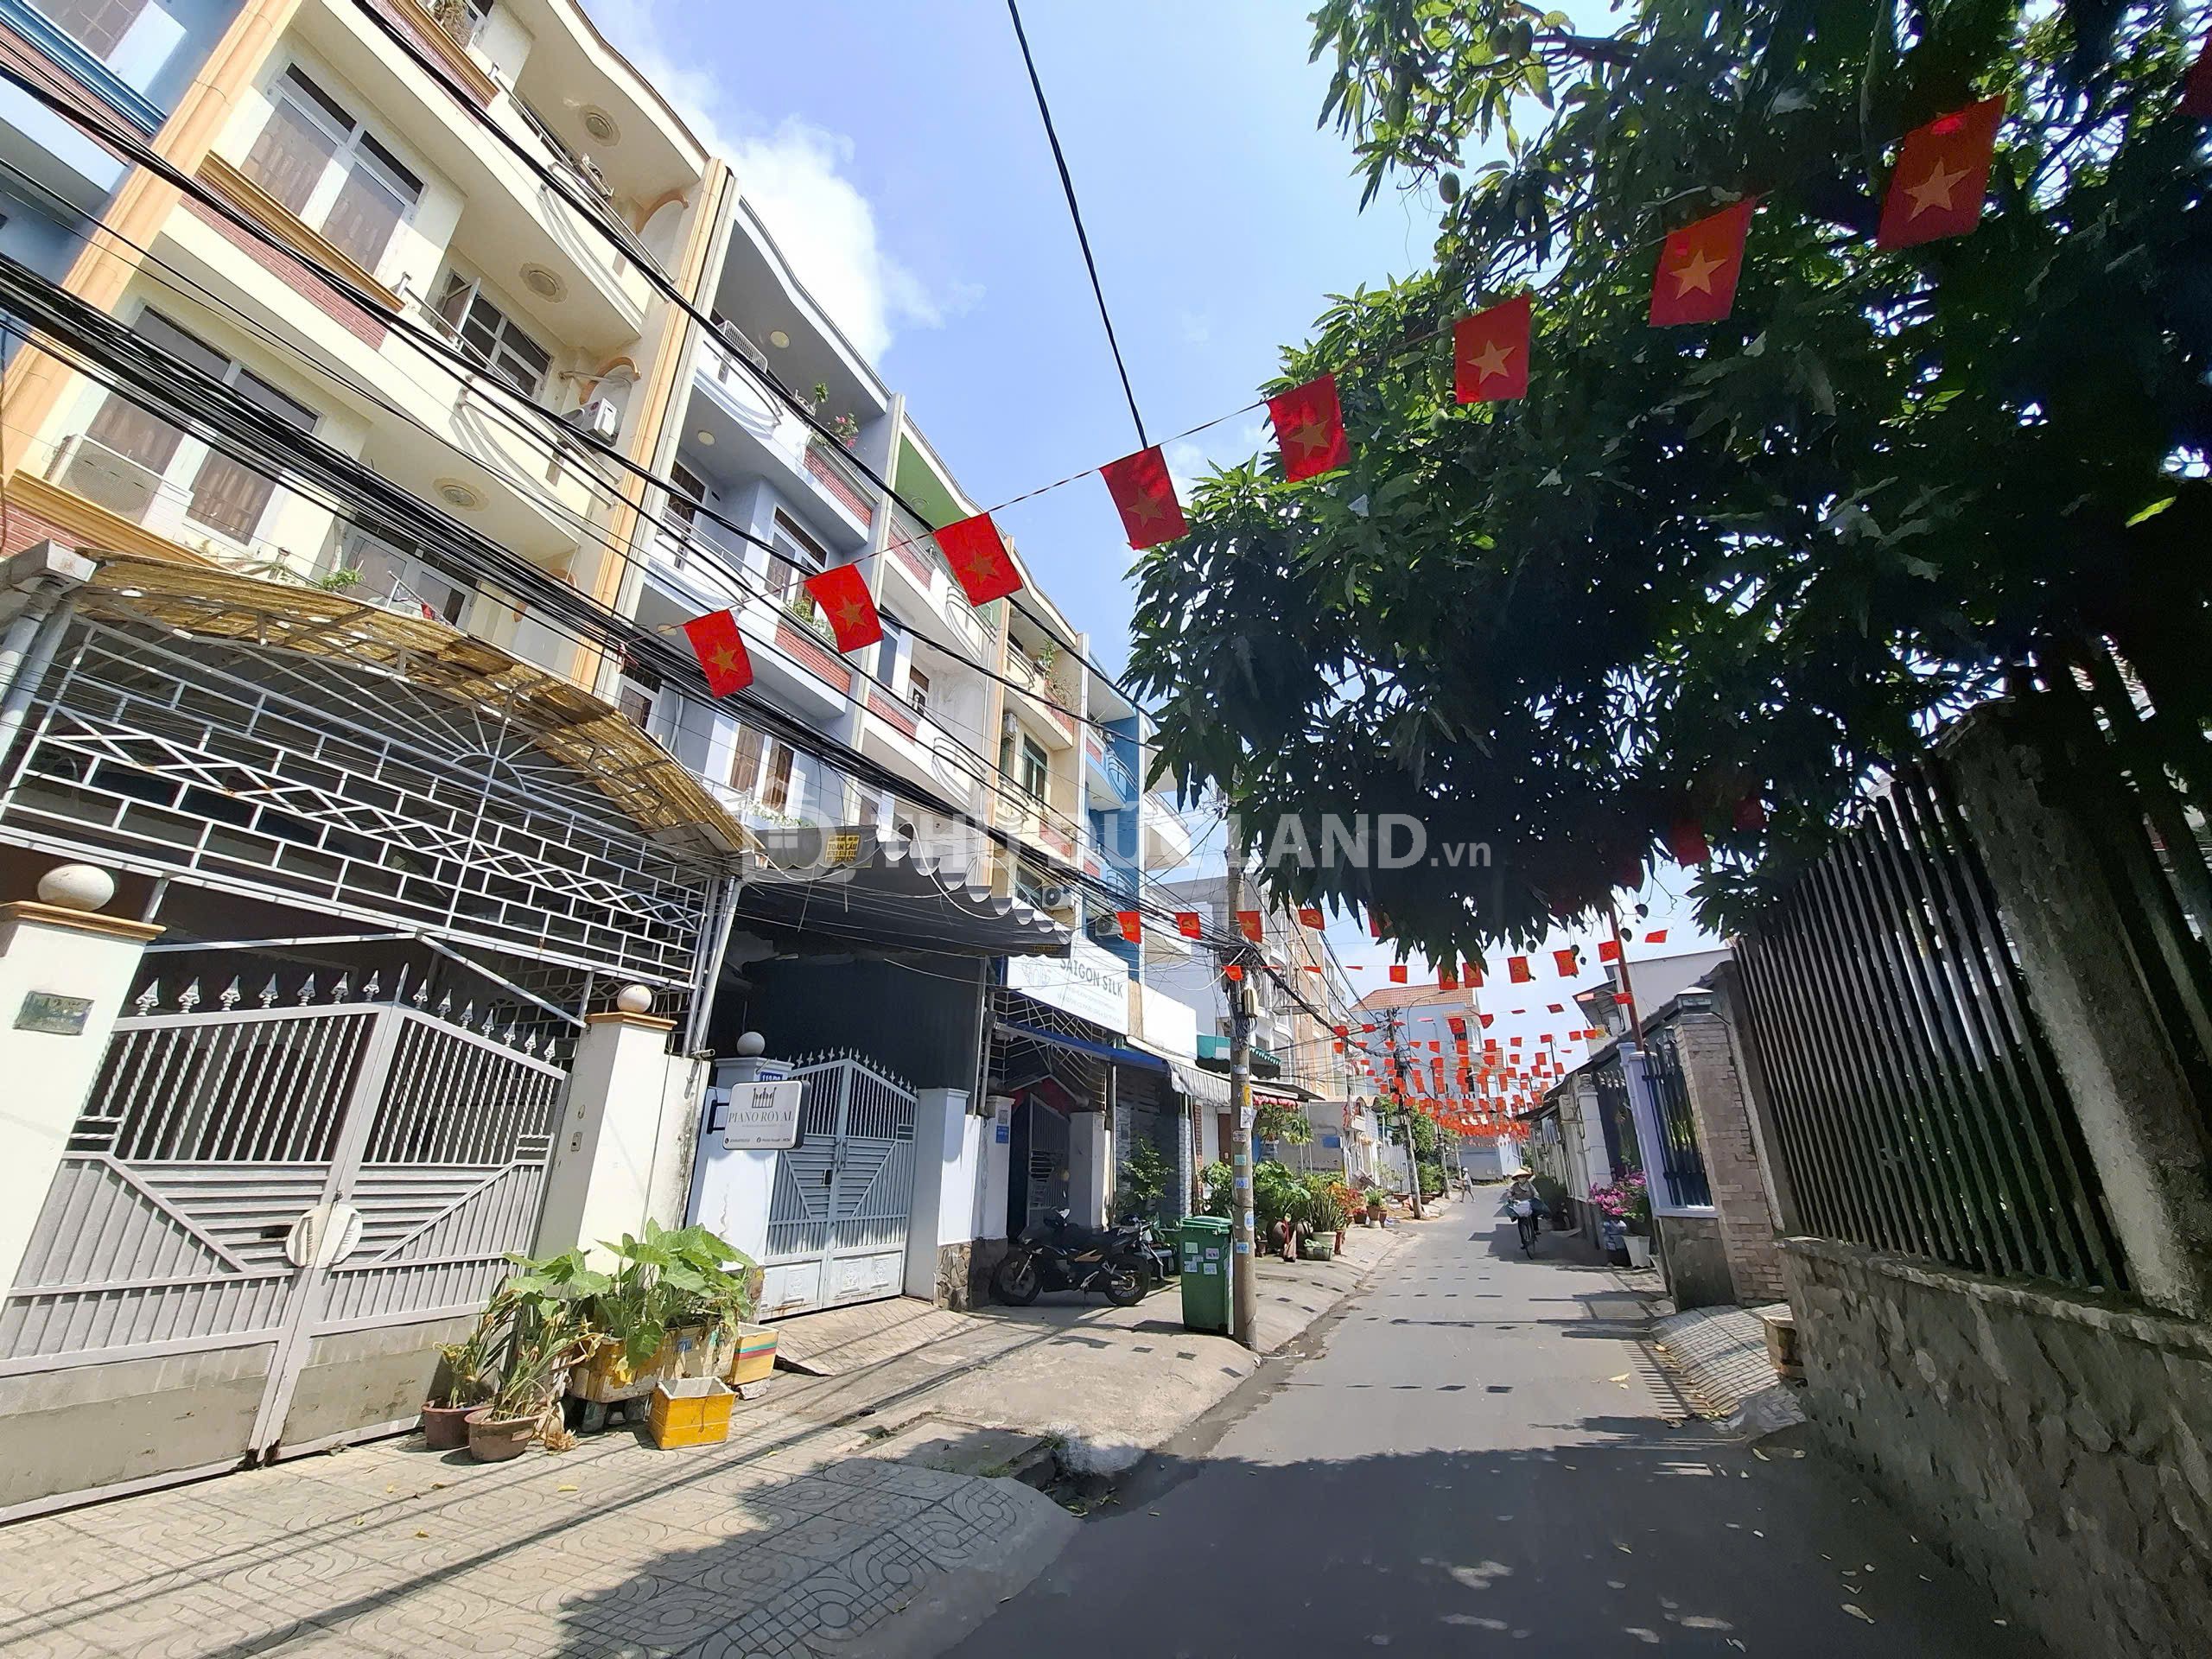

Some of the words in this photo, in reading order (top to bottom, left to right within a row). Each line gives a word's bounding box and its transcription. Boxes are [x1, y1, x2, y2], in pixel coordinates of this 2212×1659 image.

[1059, 958, 1100, 987] SAIGON
[1103, 976, 1123, 998] SILK
[728, 1111, 759, 1123] PIANO
[760, 1110, 795, 1122] ROYAL
